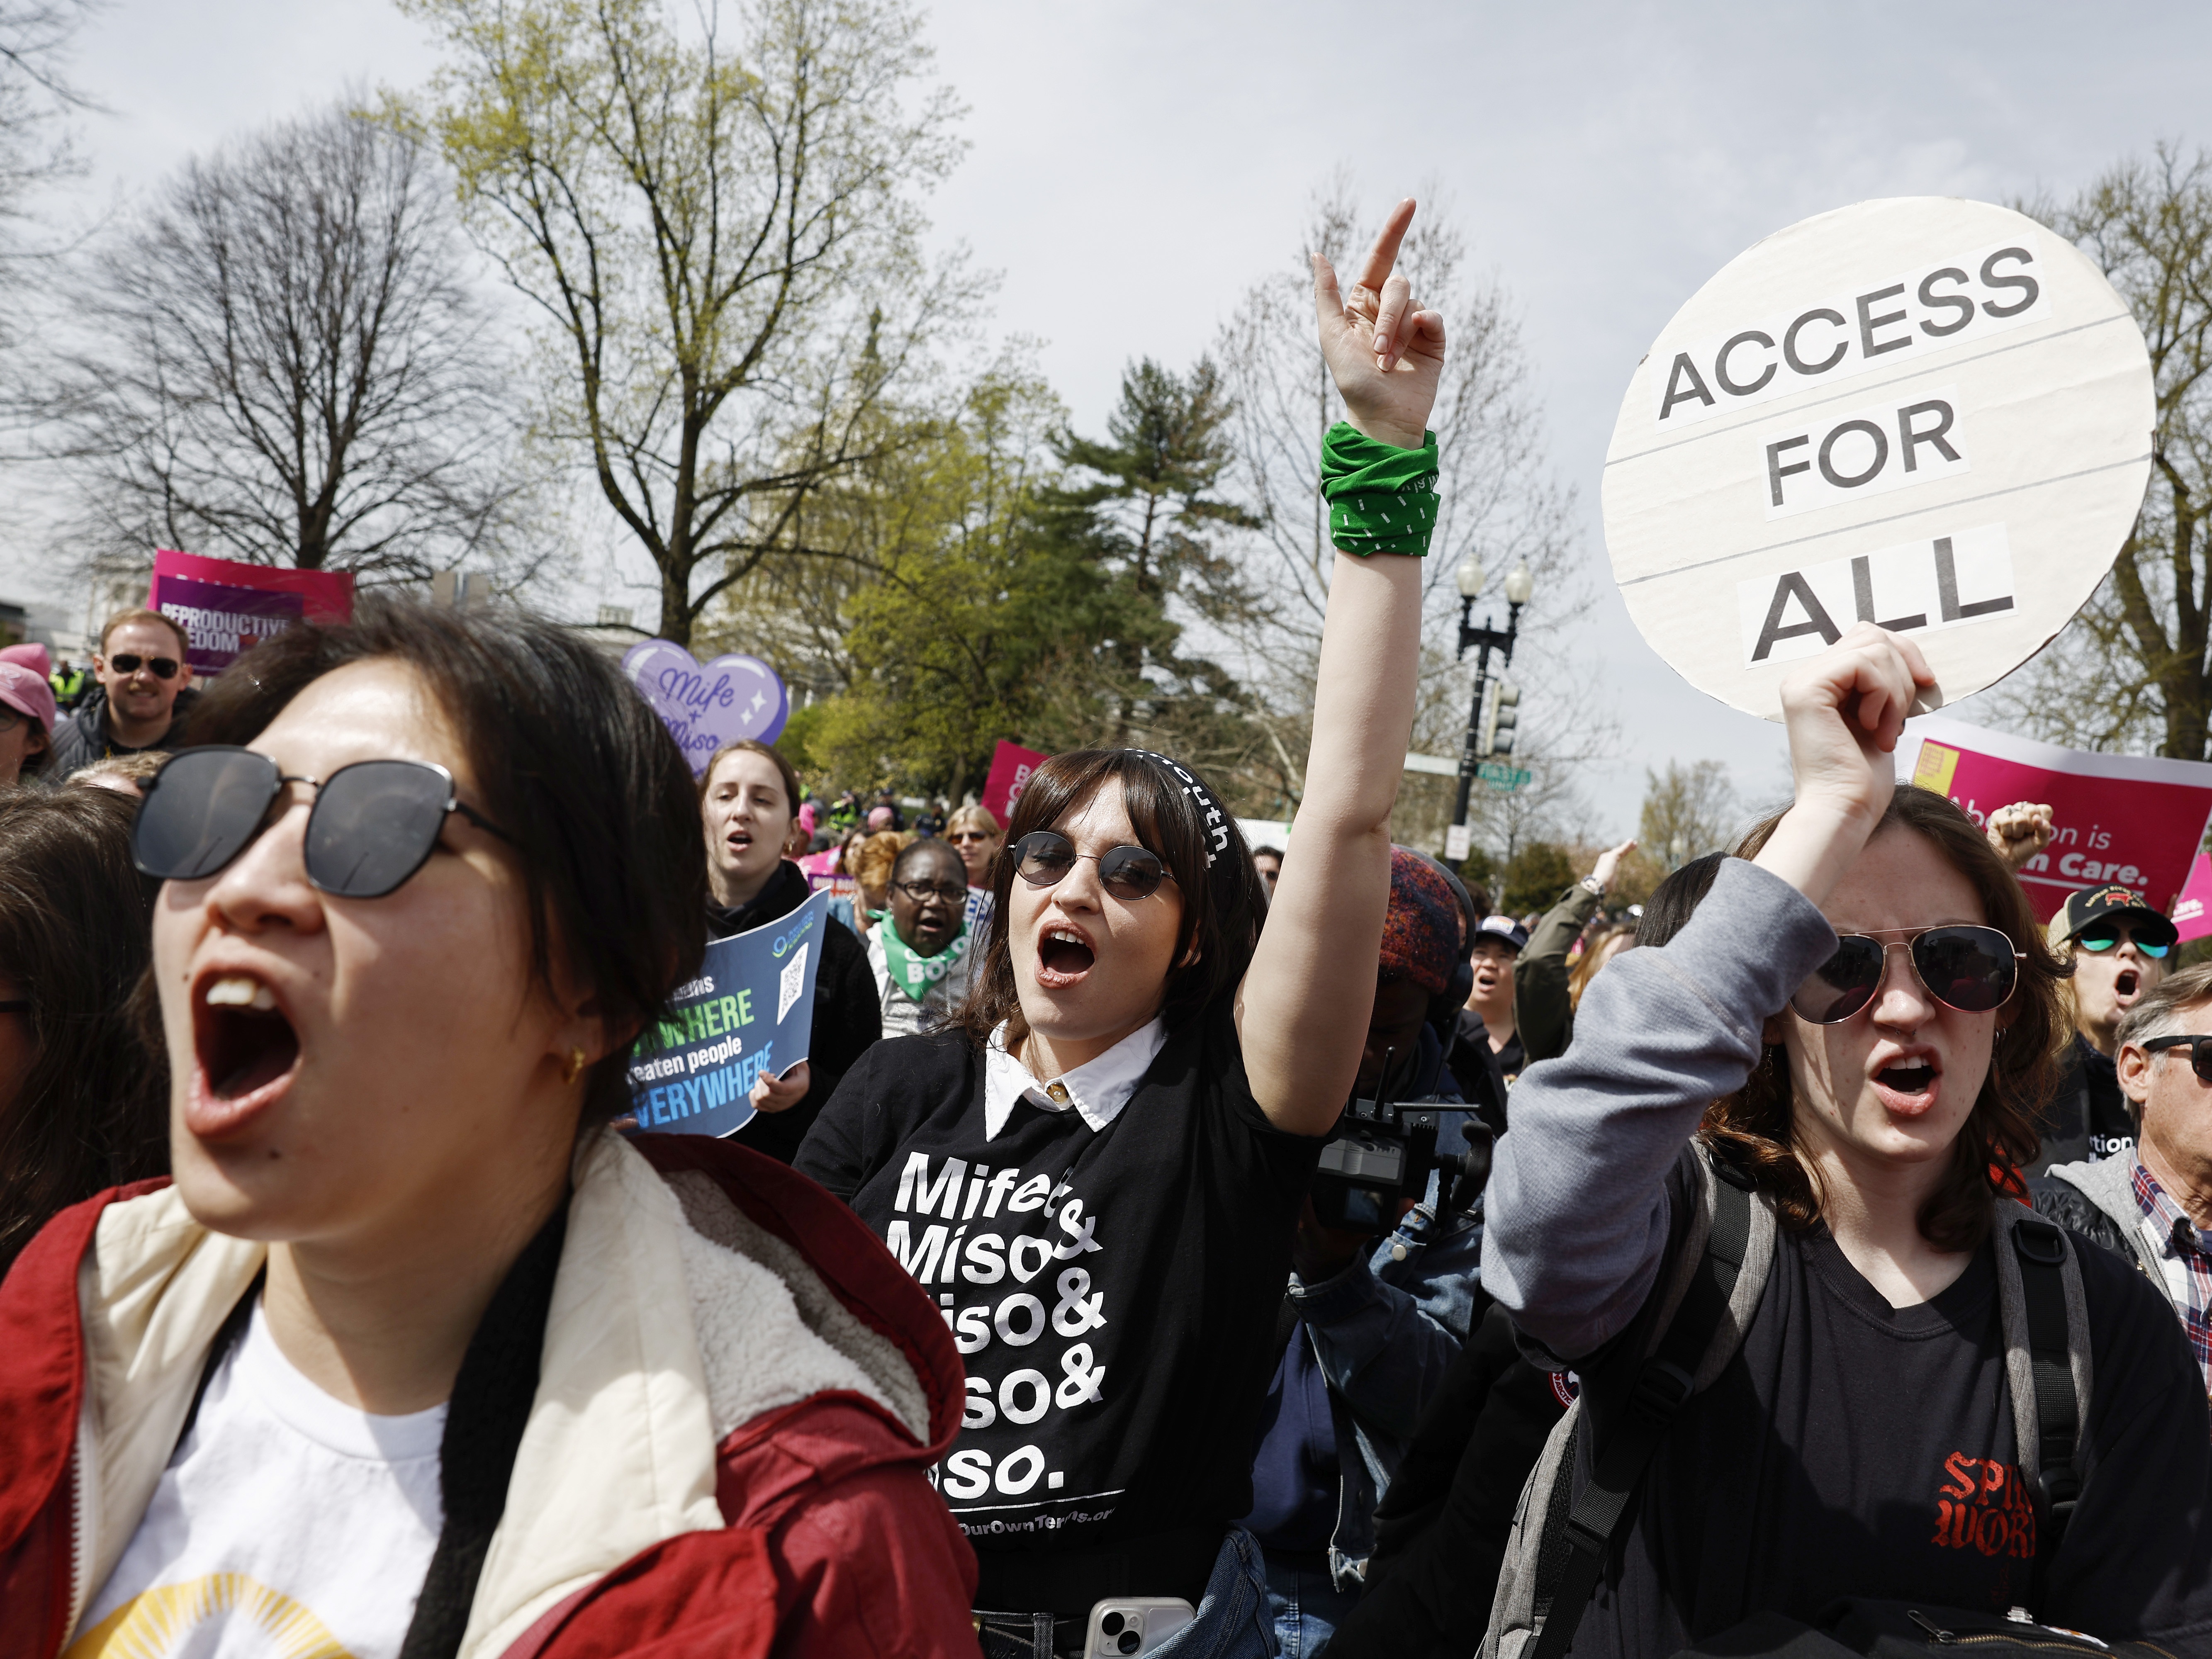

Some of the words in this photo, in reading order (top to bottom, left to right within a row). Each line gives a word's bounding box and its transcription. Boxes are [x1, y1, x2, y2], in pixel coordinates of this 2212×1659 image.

[1659, 247, 2039, 421] ACCESS
[1766, 399, 1961, 507] FOR
[1751, 536, 2014, 662] ALL
[659, 668, 734, 713] Mife
[2087, 824, 2112, 850] is
[2059, 852, 2149, 886] Care.
[687, 1035, 742, 1074] people
[632, 1040, 773, 1129] VERYWHERE
[1555, 1381, 1572, 1404] ARCTIC
